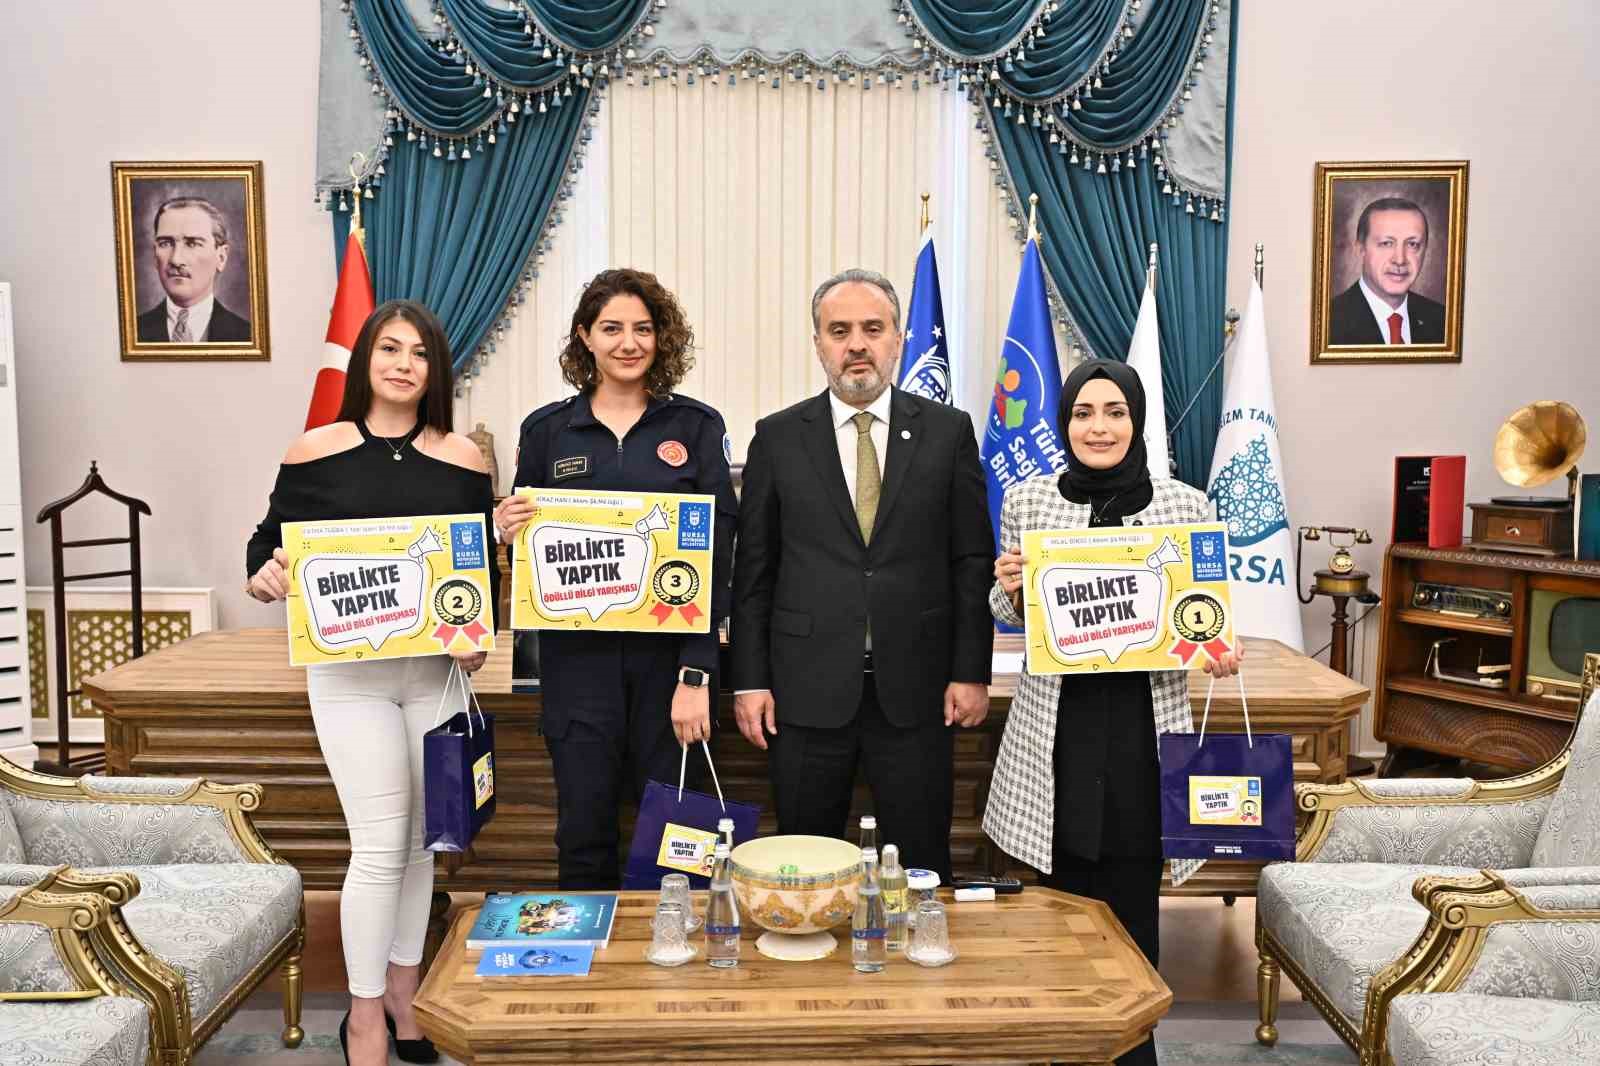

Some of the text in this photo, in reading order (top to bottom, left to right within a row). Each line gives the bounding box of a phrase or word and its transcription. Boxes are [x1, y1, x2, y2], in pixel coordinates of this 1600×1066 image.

[545, 538, 625, 563] BİRLİKTE
[317, 564, 401, 597] BİRLİKTE
[557, 562, 621, 586] YAPTIK
[670, 575, 681, 587] 3
[543, 583, 638, 602] ÖDÜLLÜ BİLGİ YARIŞMASI
[1055, 574, 1138, 606] BİRLİKTE
[331, 588, 400, 617] YAPTIK
[452, 596, 464, 608] 2
[353, 615, 375, 630] BİLGİ
[375, 608, 417, 624] YARIŞMASI
[1069, 599, 1137, 628] YAPTIK
[1194, 612, 1204, 625] 1
[1090, 627, 1112, 641] BİLGİ
[1113, 620, 1155, 637] YARIŞMASI
[1205, 800, 1228, 809] YAPTIK
